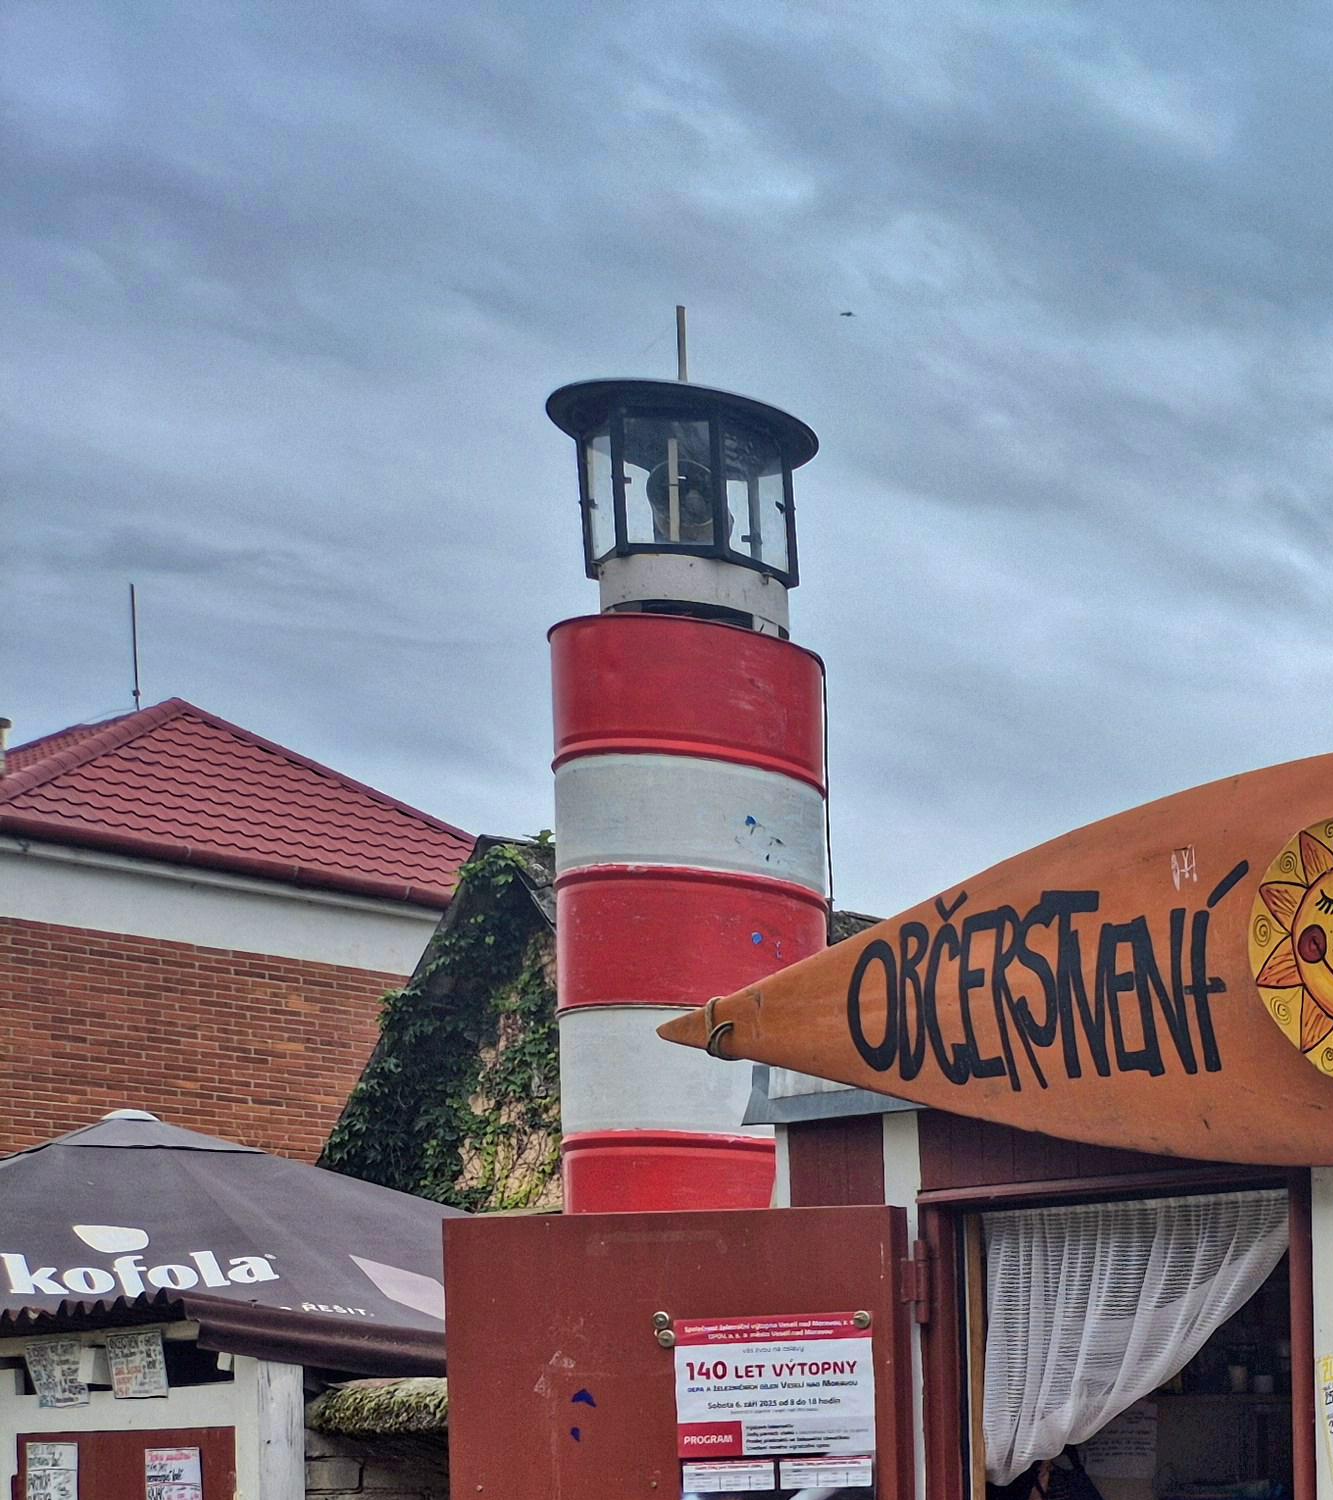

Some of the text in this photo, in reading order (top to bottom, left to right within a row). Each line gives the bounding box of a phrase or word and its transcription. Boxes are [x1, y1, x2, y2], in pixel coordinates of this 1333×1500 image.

[1, 1250, 280, 1298] kofola
[686, 1359, 857, 1381] 140 LET VÝTOPNY
[708, 1402, 734, 1410] Sobota
[779, 1398, 789, 1406] od
[818, 1397, 841, 1405] hodin
[683, 1434, 733, 1445] PROGRAM
